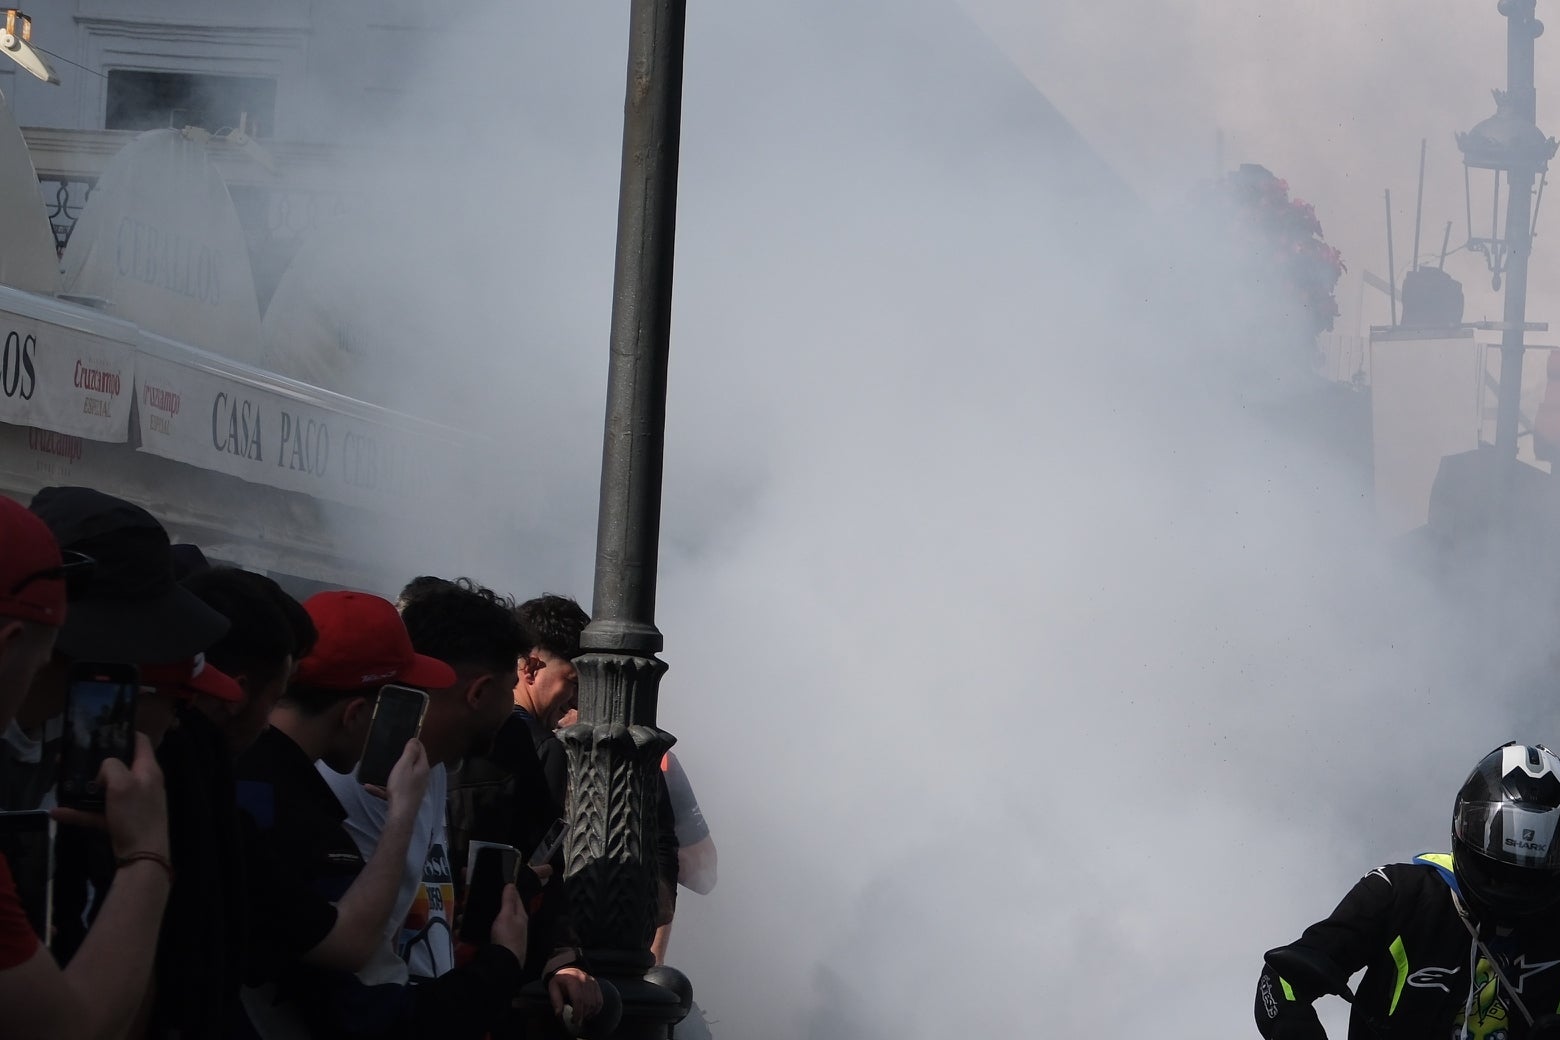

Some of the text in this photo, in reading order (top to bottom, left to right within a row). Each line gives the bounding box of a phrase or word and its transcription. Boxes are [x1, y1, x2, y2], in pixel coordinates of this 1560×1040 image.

[0, 330, 36, 400] OS
[74, 359, 121, 399] Cruzcampo
[212, 391, 264, 461] CASA
[277, 411, 330, 478] PACO
[1504, 838, 1547, 852] SHARK
